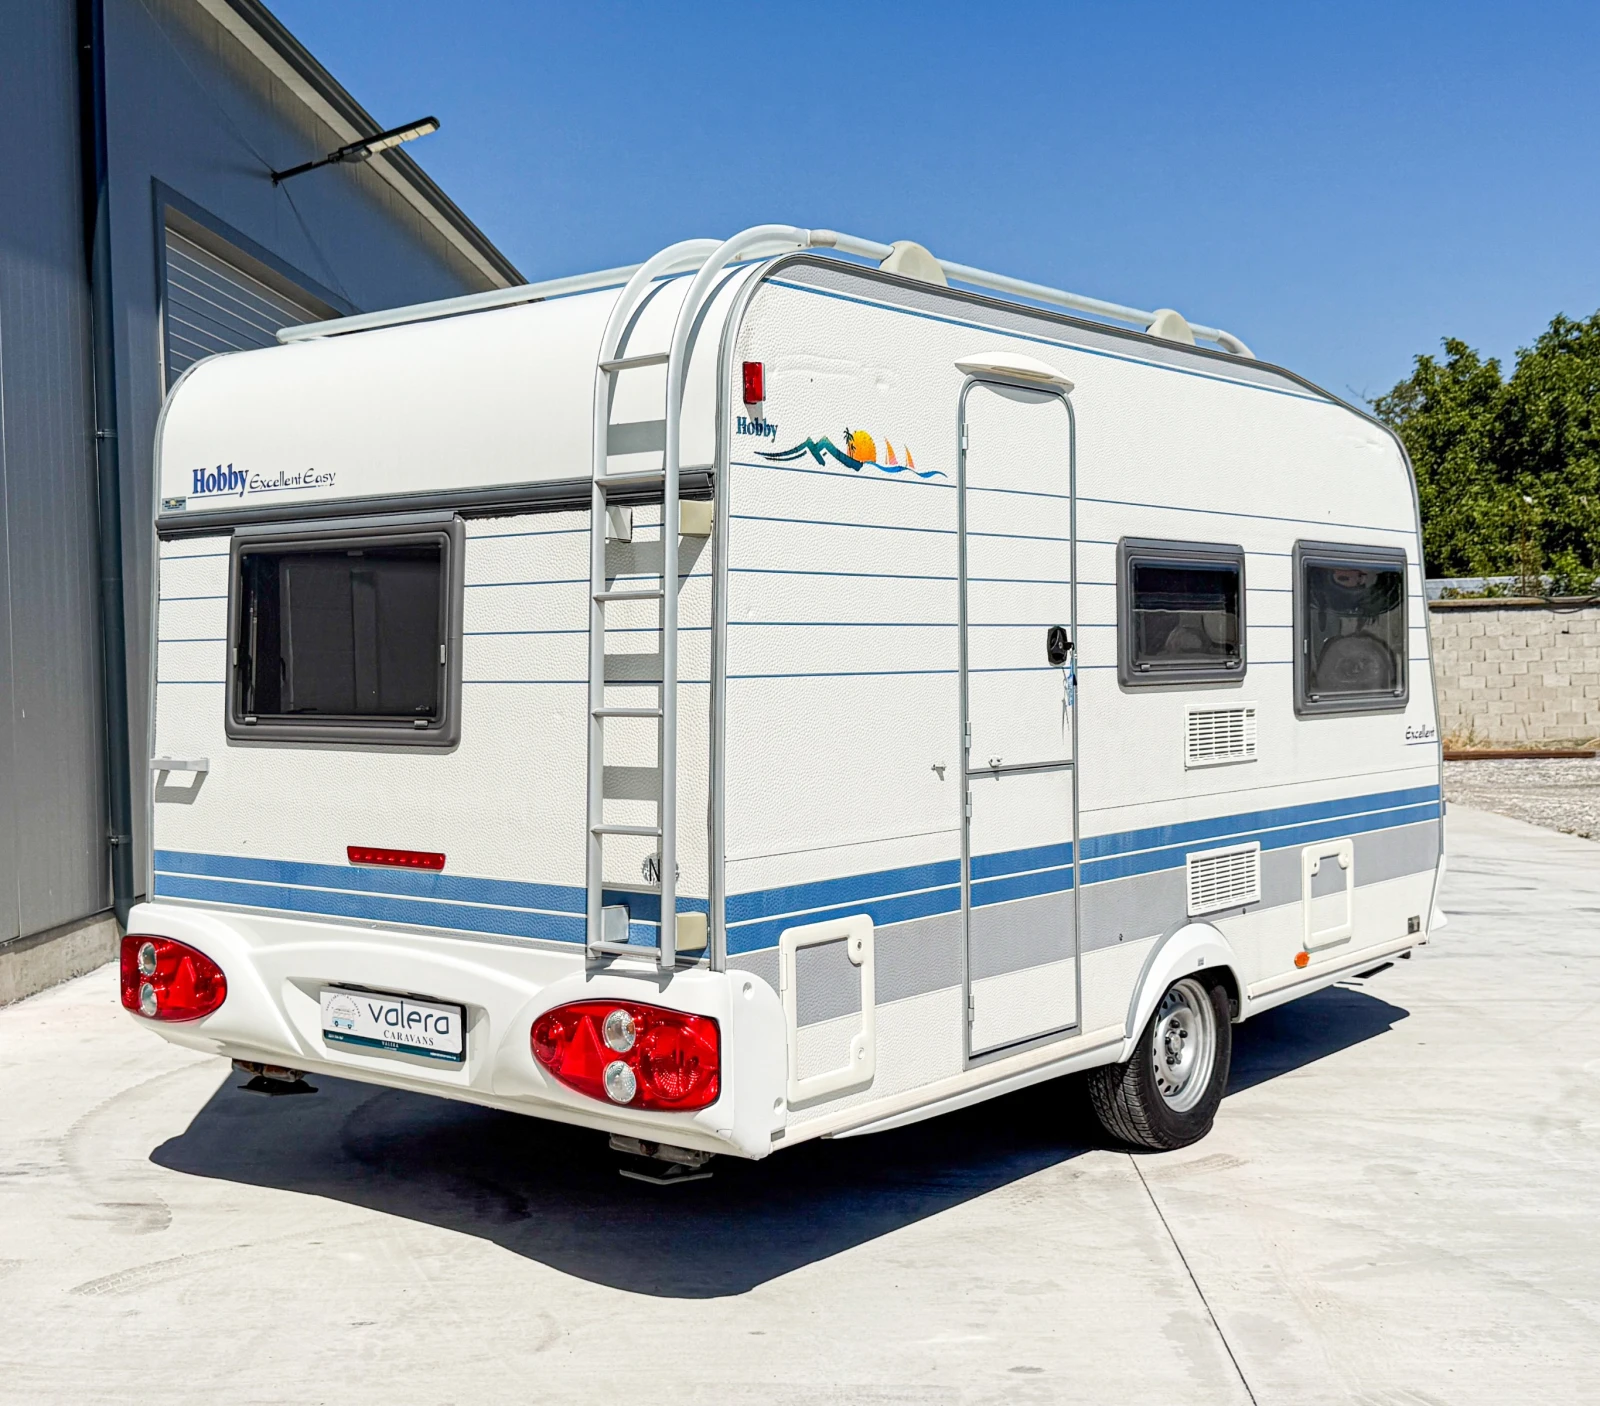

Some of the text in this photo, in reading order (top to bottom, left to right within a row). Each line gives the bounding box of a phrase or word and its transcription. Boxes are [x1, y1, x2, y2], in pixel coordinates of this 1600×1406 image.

[736, 416, 778, 443] Hobby
[192, 463, 249, 497] Hobby
[383, 1030, 434, 1046] CARAVANS
